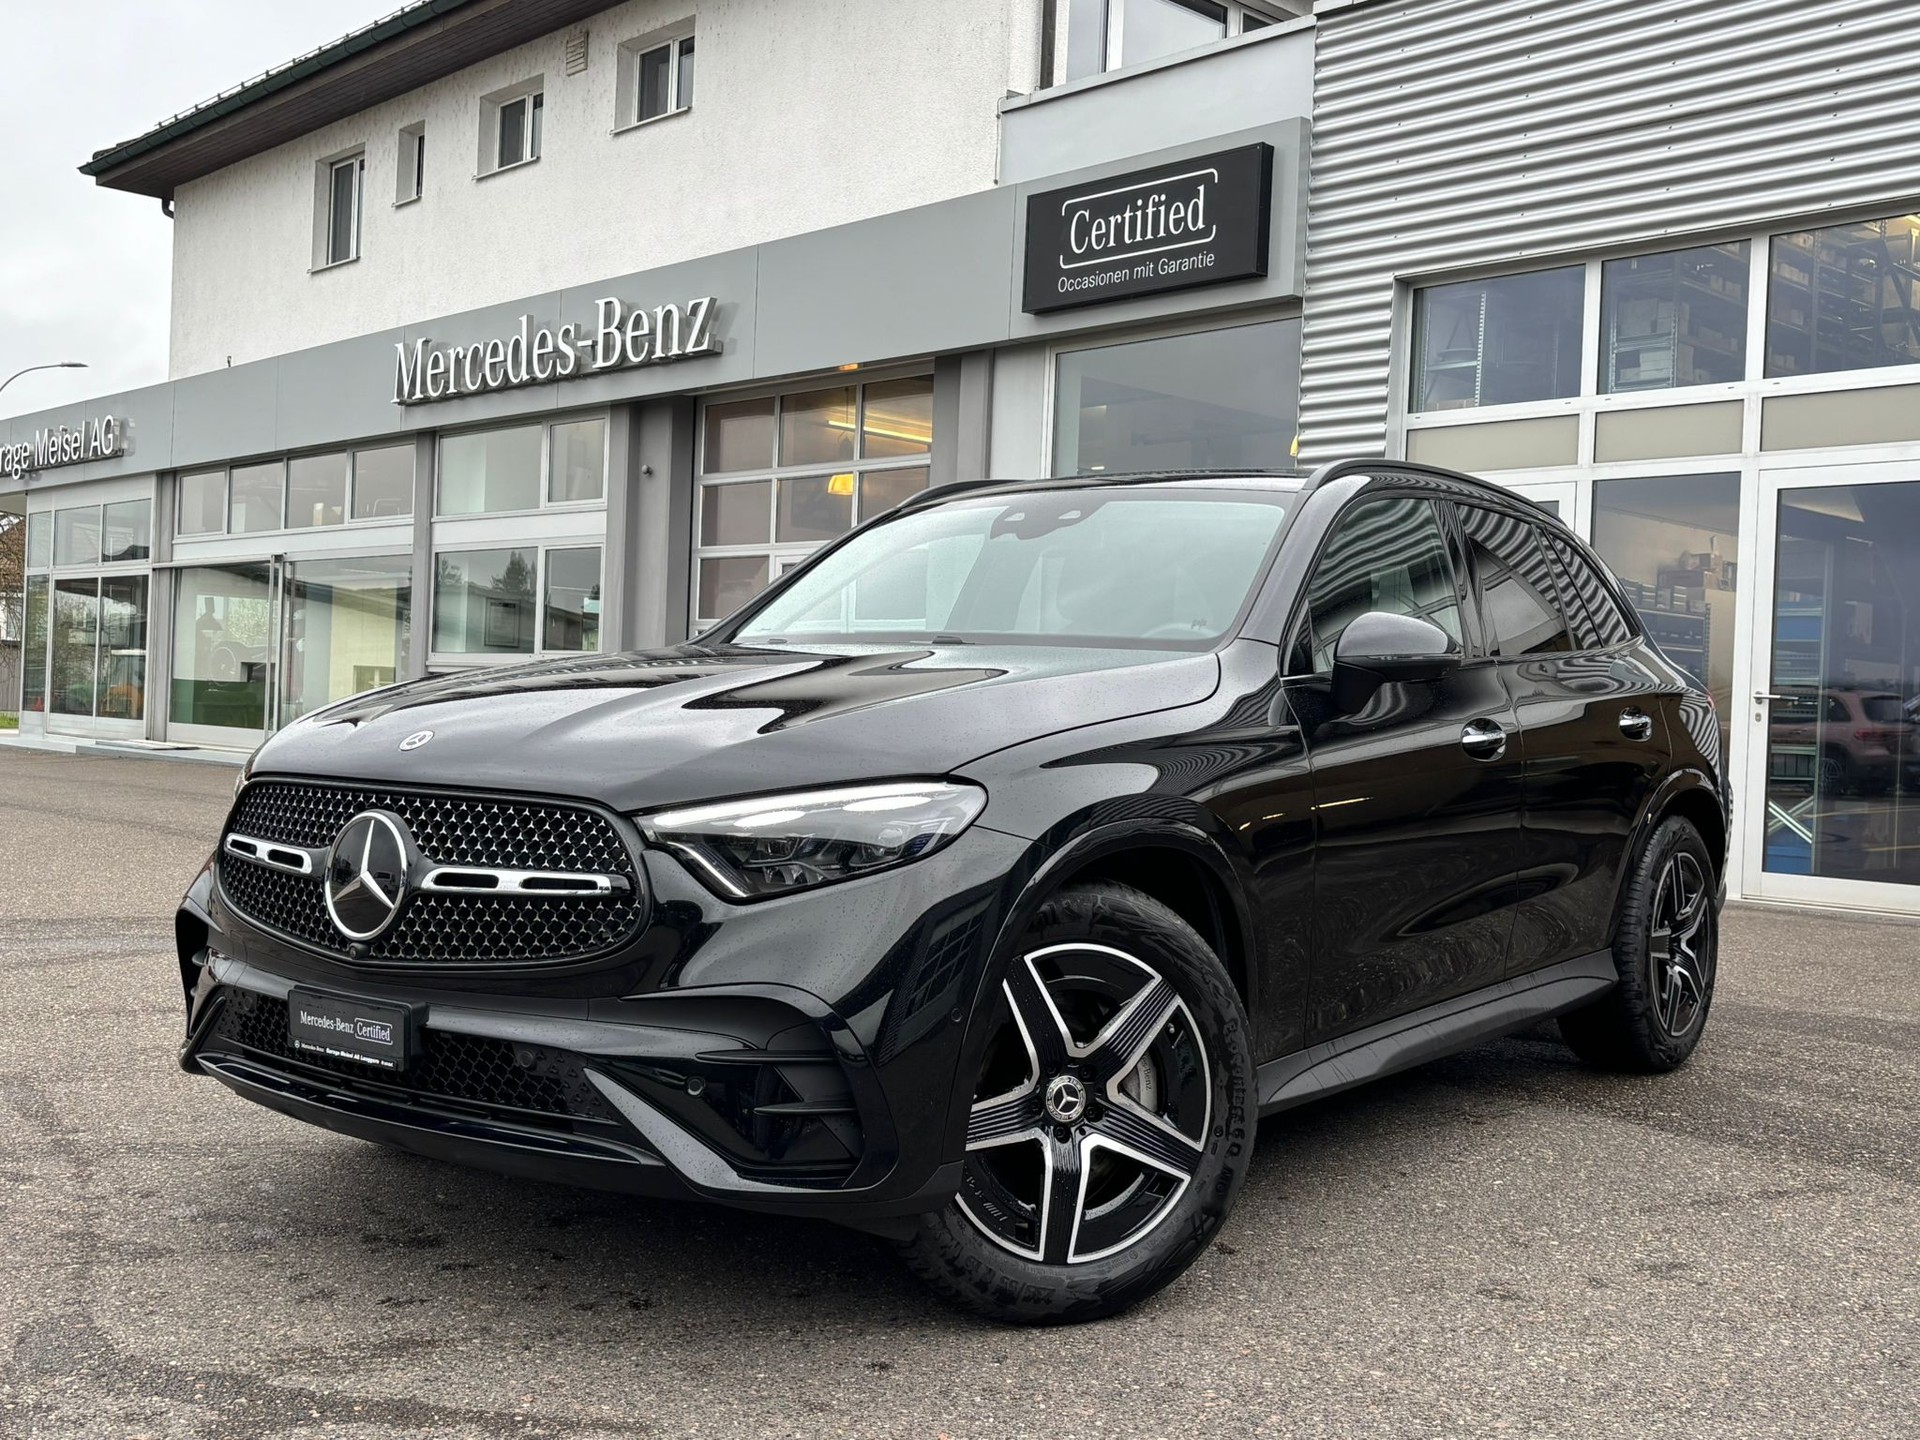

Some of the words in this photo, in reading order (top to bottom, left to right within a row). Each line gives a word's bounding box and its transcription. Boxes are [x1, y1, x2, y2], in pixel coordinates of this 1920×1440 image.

[1070, 184, 1206, 255] Certified
[1057, 268, 1130, 293] Occasionen
[1133, 260, 1154, 280] mit
[1157, 251, 1216, 276] Garantie
[390, 296, 718, 404] Mercedes-Benz
[34, 420, 87, 468] Meisel
[89, 414, 114, 456] AG
[300, 1010, 355, 1034] Mercedes-Benz
[356, 1021, 391, 1041] Certified
